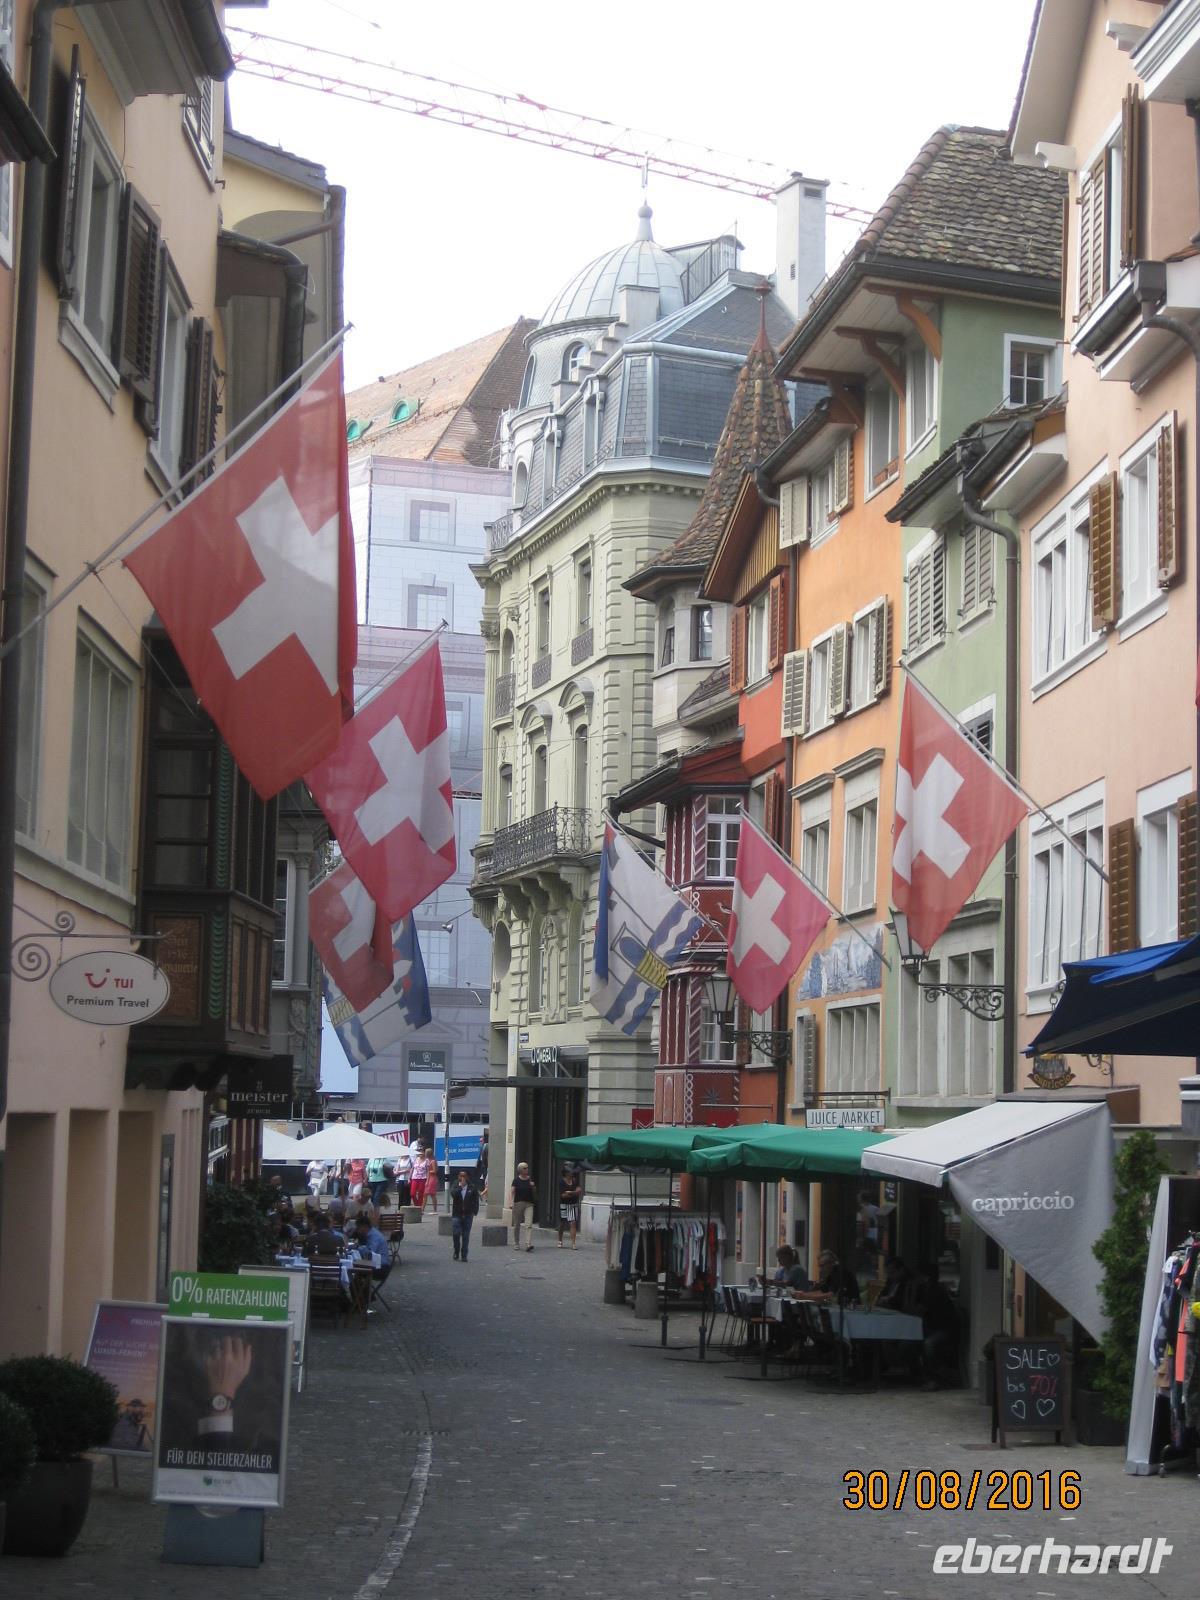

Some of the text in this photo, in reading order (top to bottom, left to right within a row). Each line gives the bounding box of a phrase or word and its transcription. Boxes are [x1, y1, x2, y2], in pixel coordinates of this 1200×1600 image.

[114, 978, 134, 989] TUI
[66, 995, 150, 1008] Premium Travel
[231, 1092, 289, 1103] meister
[810, 1110, 881, 1126] JUICE MARKET
[971, 1191, 1075, 1217] capriccio
[172, 1276, 287, 1308] 0% RATENZAHLUNG
[1006, 1347, 1048, 1370] SALE
[1006, 1374, 1057, 1397] bis 70%
[167, 1448, 272, 1469] FÜR DEN STEUERZAHLER
